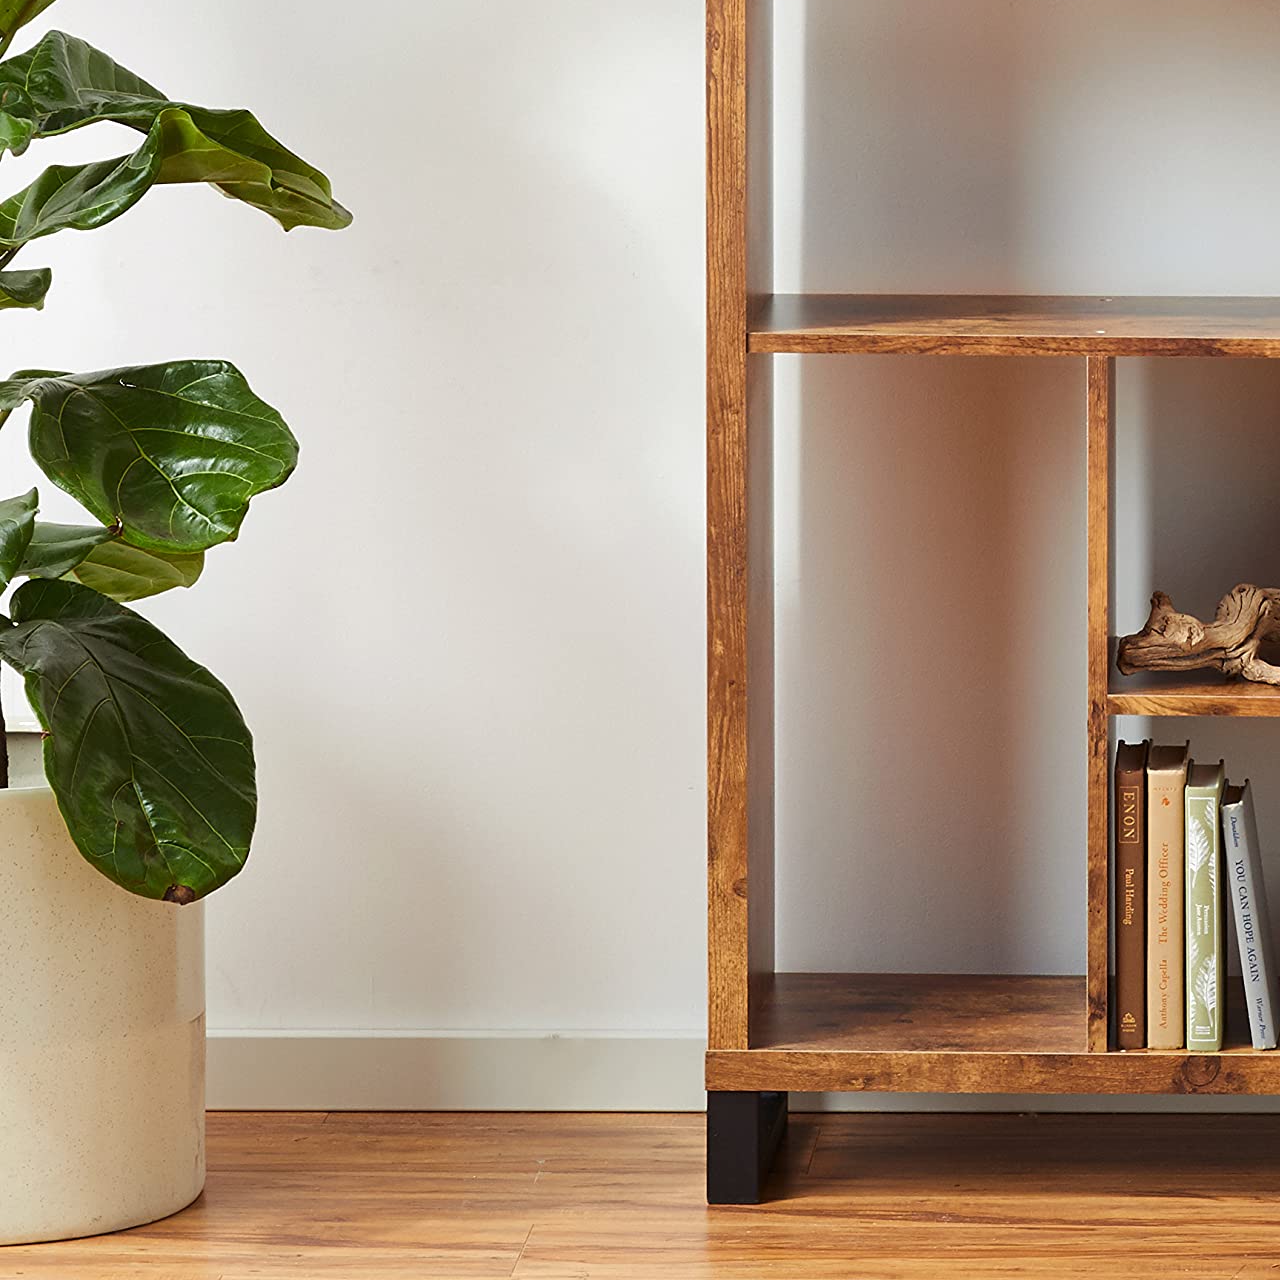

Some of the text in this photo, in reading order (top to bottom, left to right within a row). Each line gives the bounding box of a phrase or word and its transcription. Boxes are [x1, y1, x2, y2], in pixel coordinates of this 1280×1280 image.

[1123, 792, 1135, 839] ENON
[1123, 868, 1135, 925] Paul Harding
[1158, 842, 1171, 944] The Wedding Officer
[1235, 859, 1259, 982] YOU CAN HOPE AGAIN
[1159, 959, 1170, 1029] Anthony Capella
